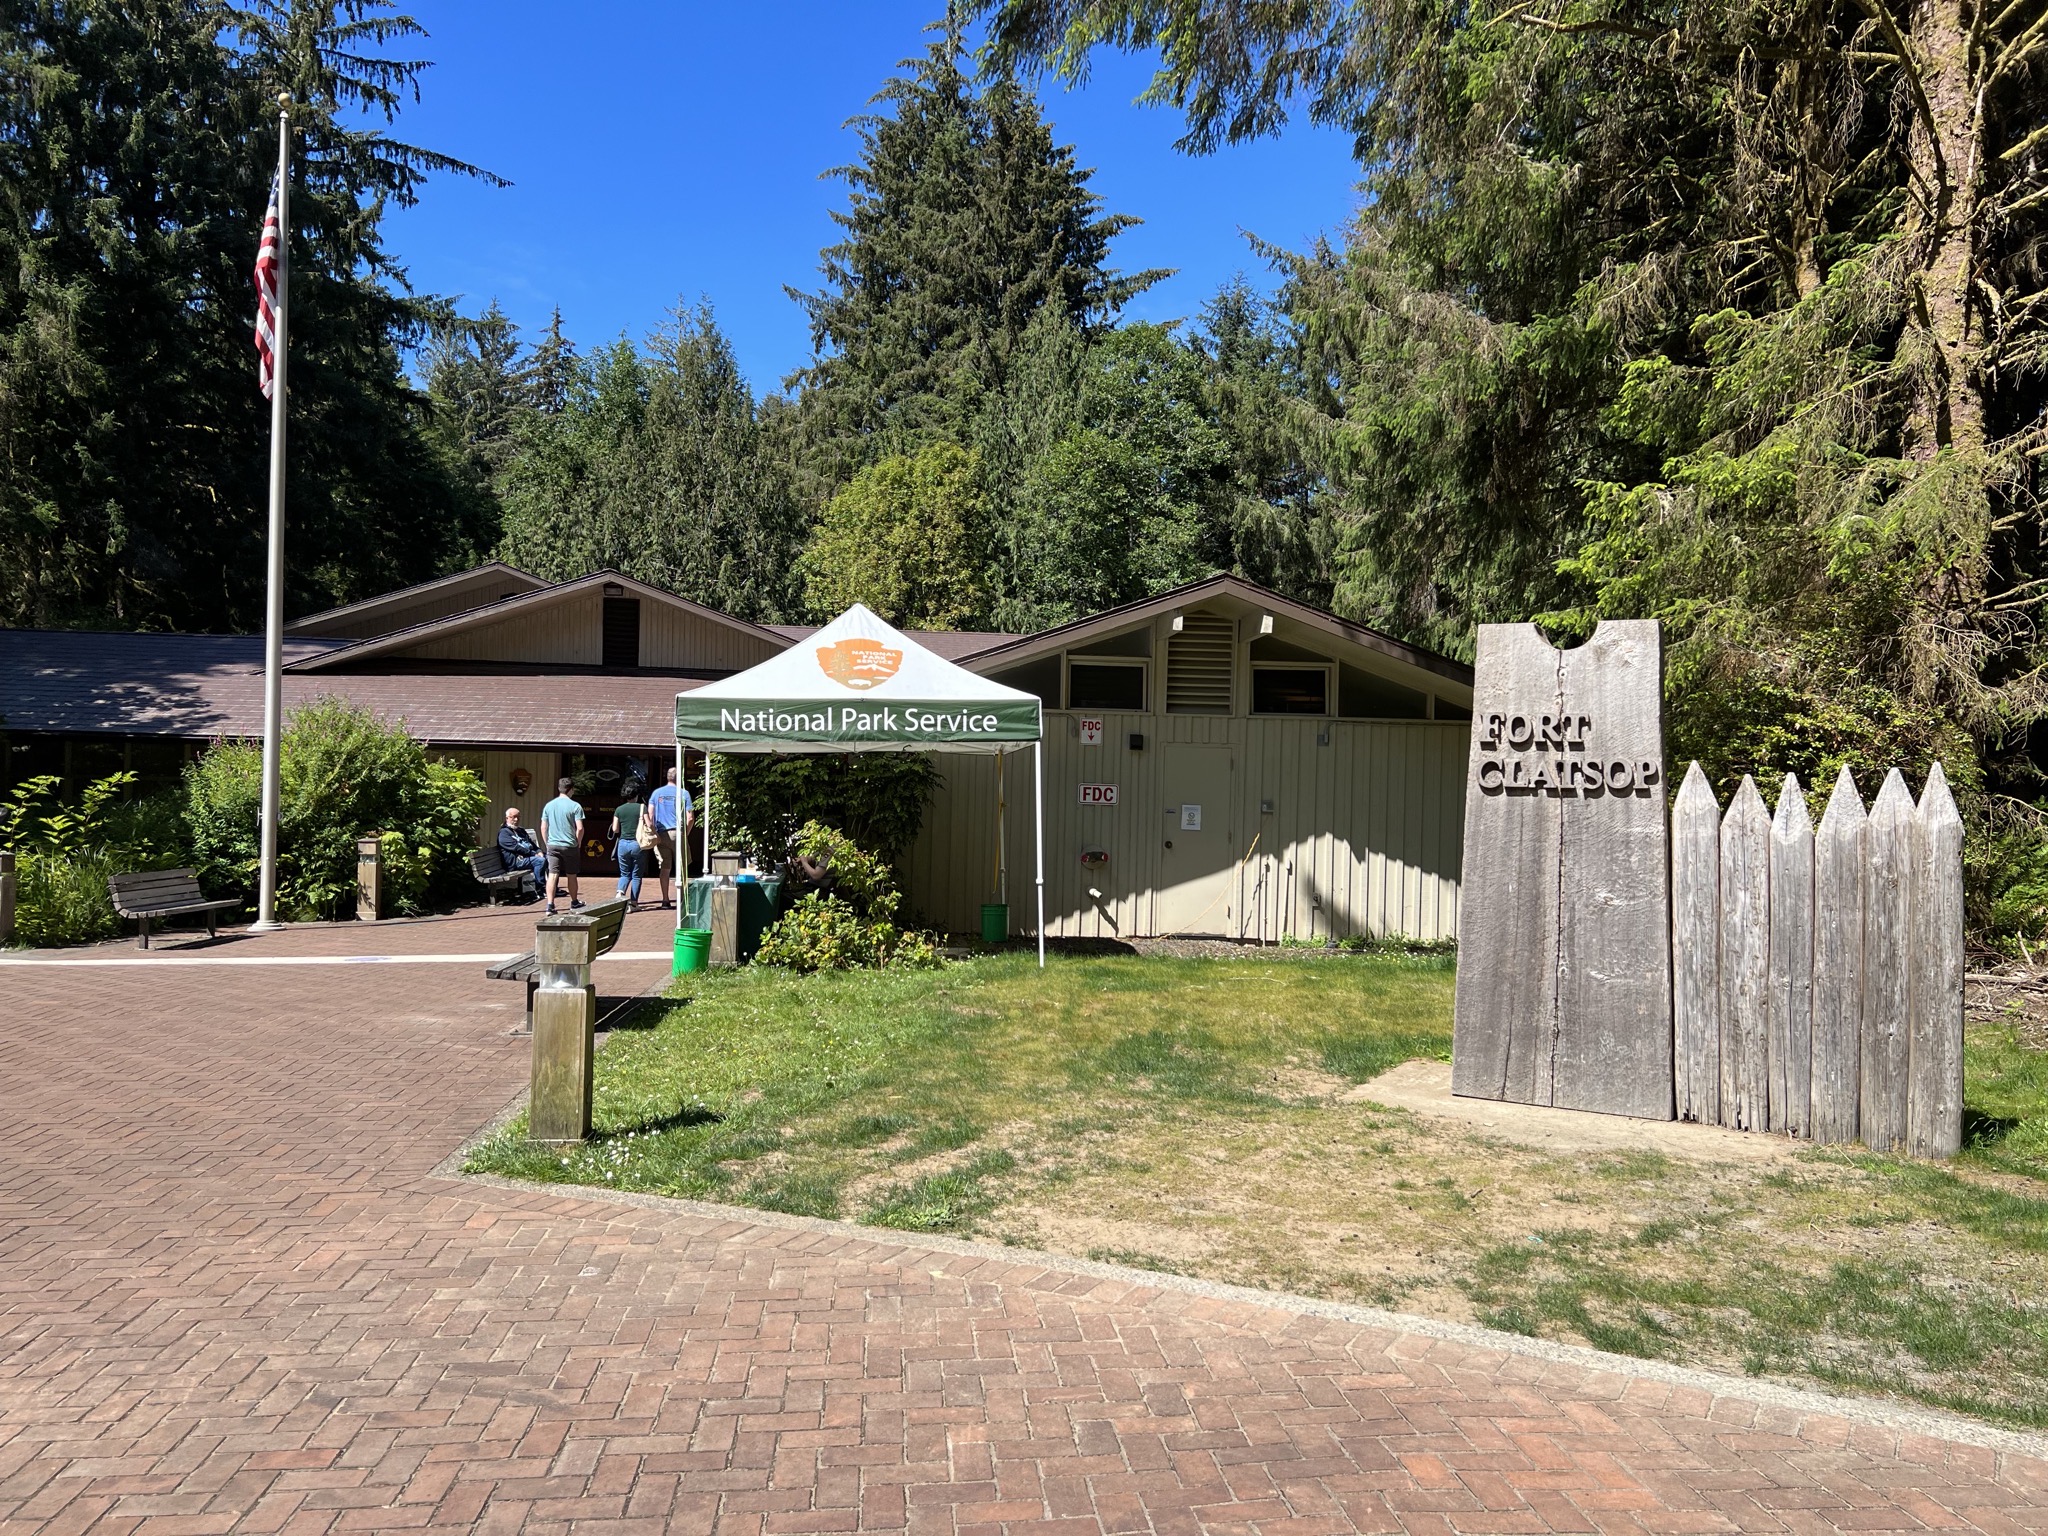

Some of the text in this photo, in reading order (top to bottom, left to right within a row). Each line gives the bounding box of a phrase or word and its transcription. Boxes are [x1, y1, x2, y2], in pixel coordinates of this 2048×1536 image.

[721, 707, 998, 732] National Park Service
[1082, 721, 1101, 731] FDC
[1478, 712, 1591, 745] FORT
[1476, 758, 1660, 792] CLATSOP
[1082, 787, 1114, 802] FDC
